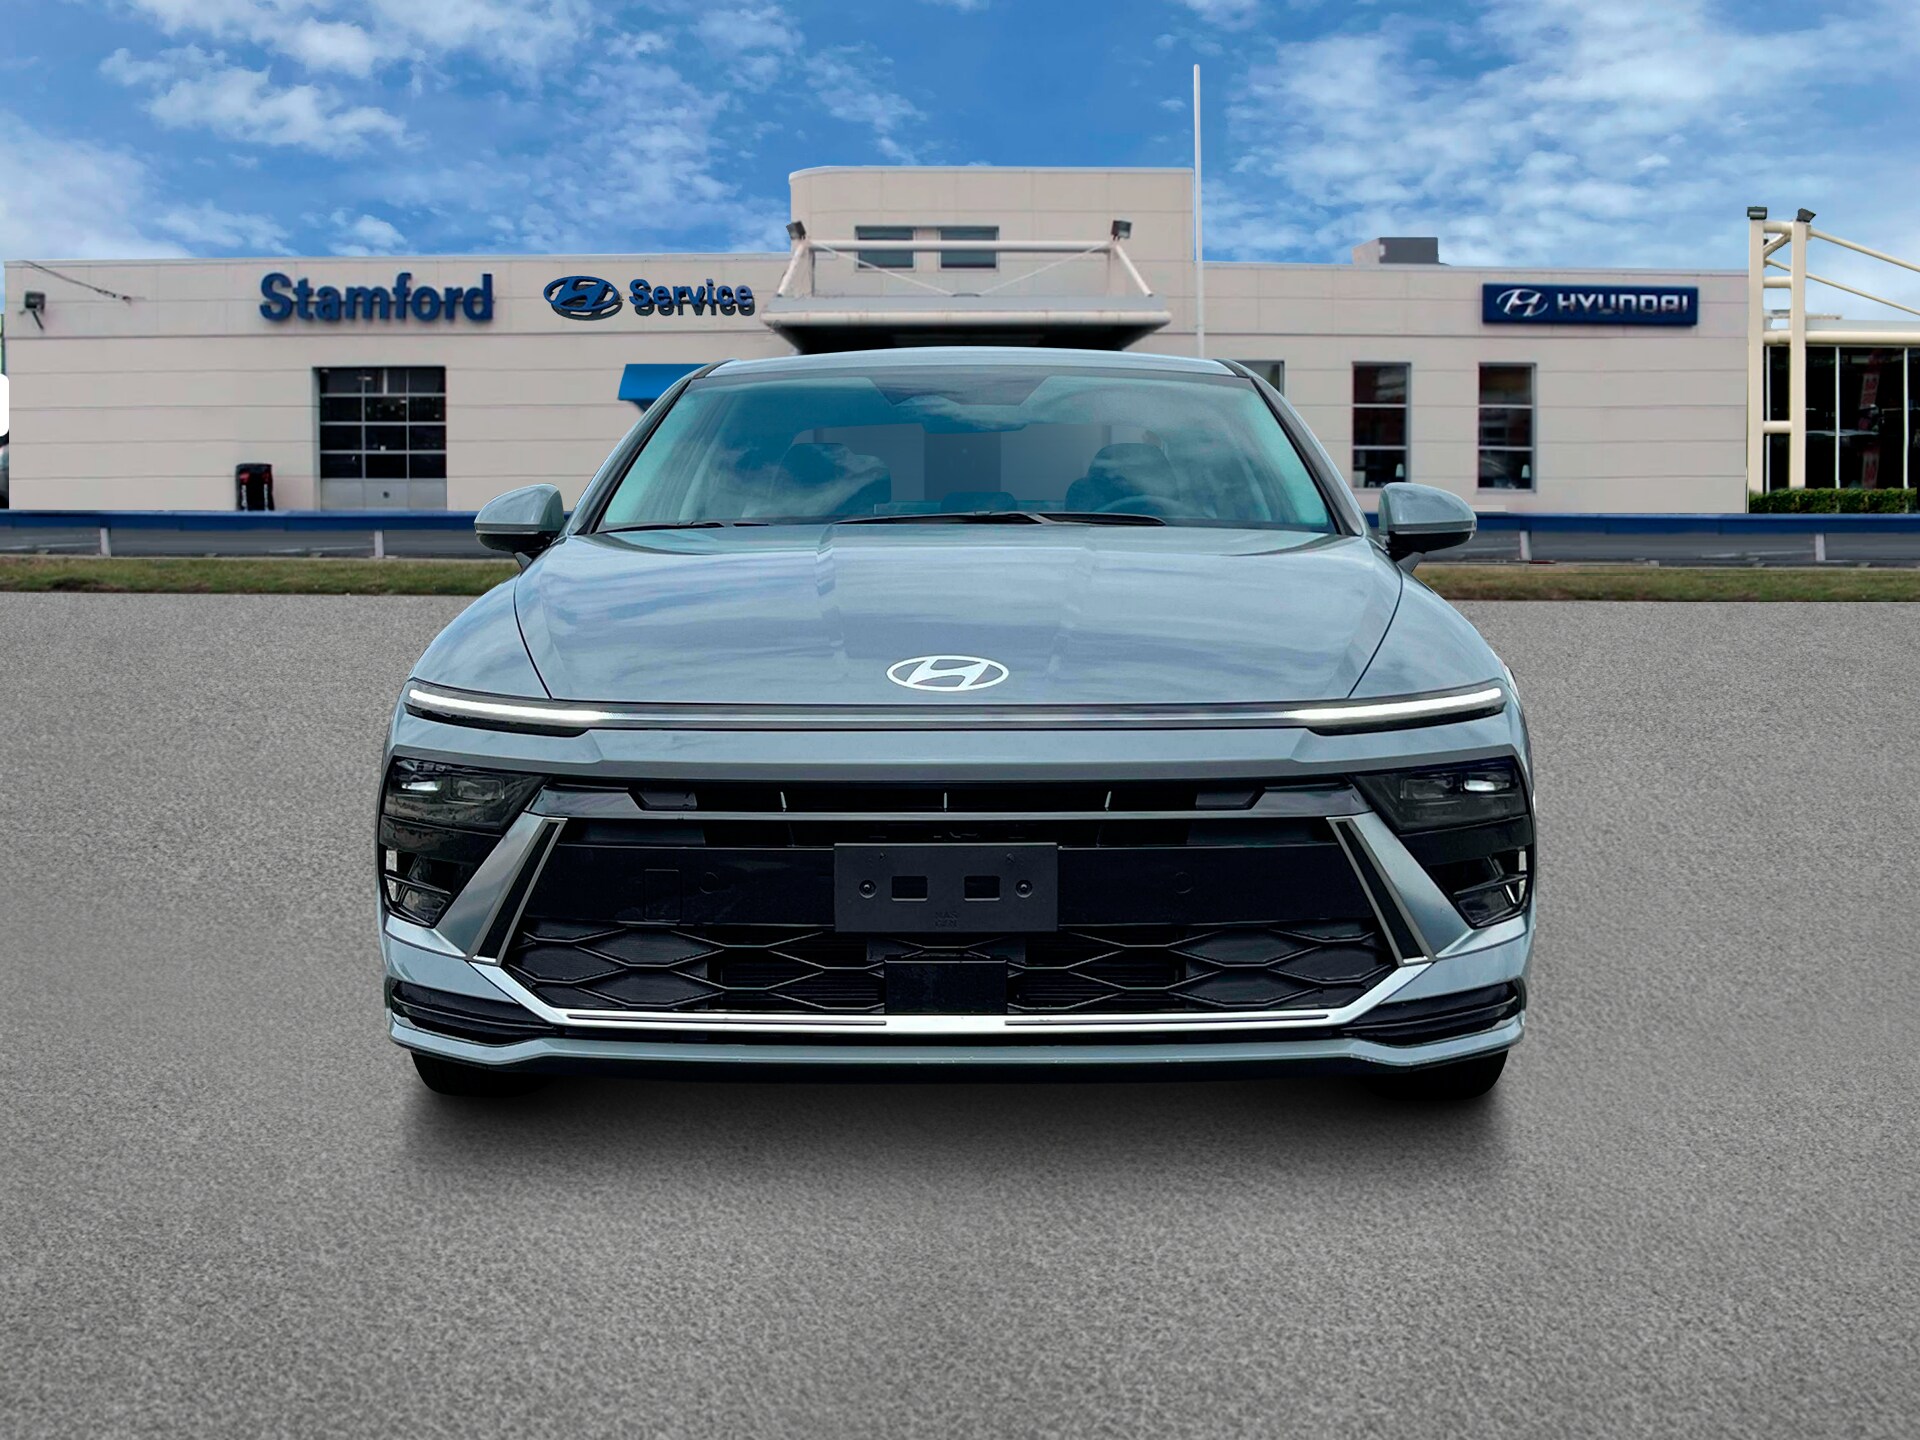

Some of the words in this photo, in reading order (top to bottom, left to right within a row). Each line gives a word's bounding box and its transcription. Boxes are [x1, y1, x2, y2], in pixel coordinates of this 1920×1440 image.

[260, 272, 493, 321] Stamford
[629, 278, 753, 306] Service
[1557, 293, 1688, 314] HYUNDAI
